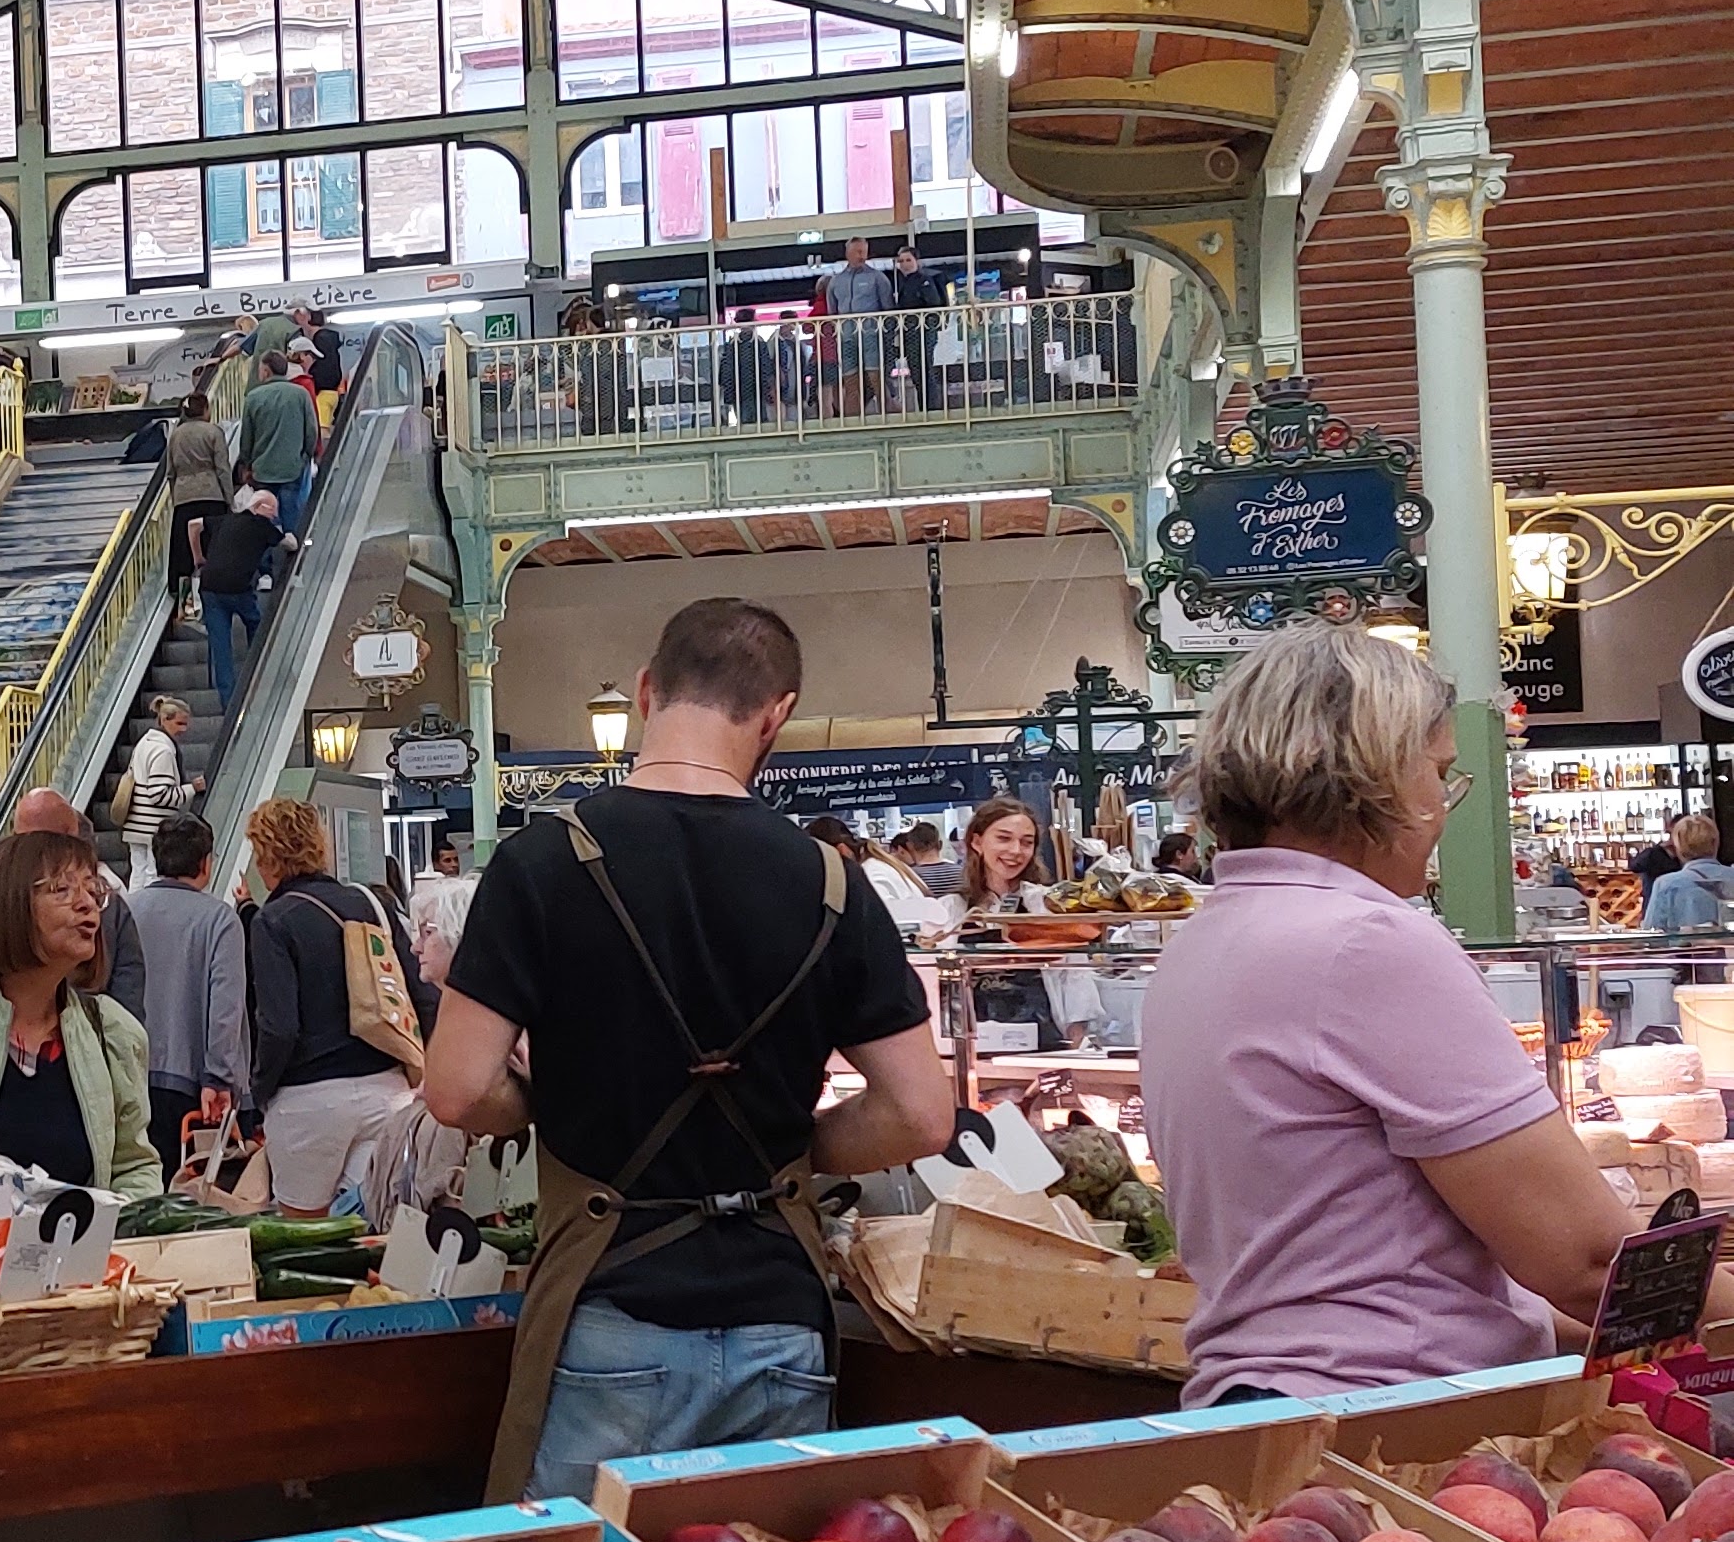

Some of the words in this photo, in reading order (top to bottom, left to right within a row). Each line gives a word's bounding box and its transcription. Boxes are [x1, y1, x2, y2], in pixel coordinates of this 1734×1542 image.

[106, 302, 179, 324] Terre
[194, 295, 222, 316] de
[1266, 477, 1307, 501] Les
[1237, 493, 1347, 533] Fromages
